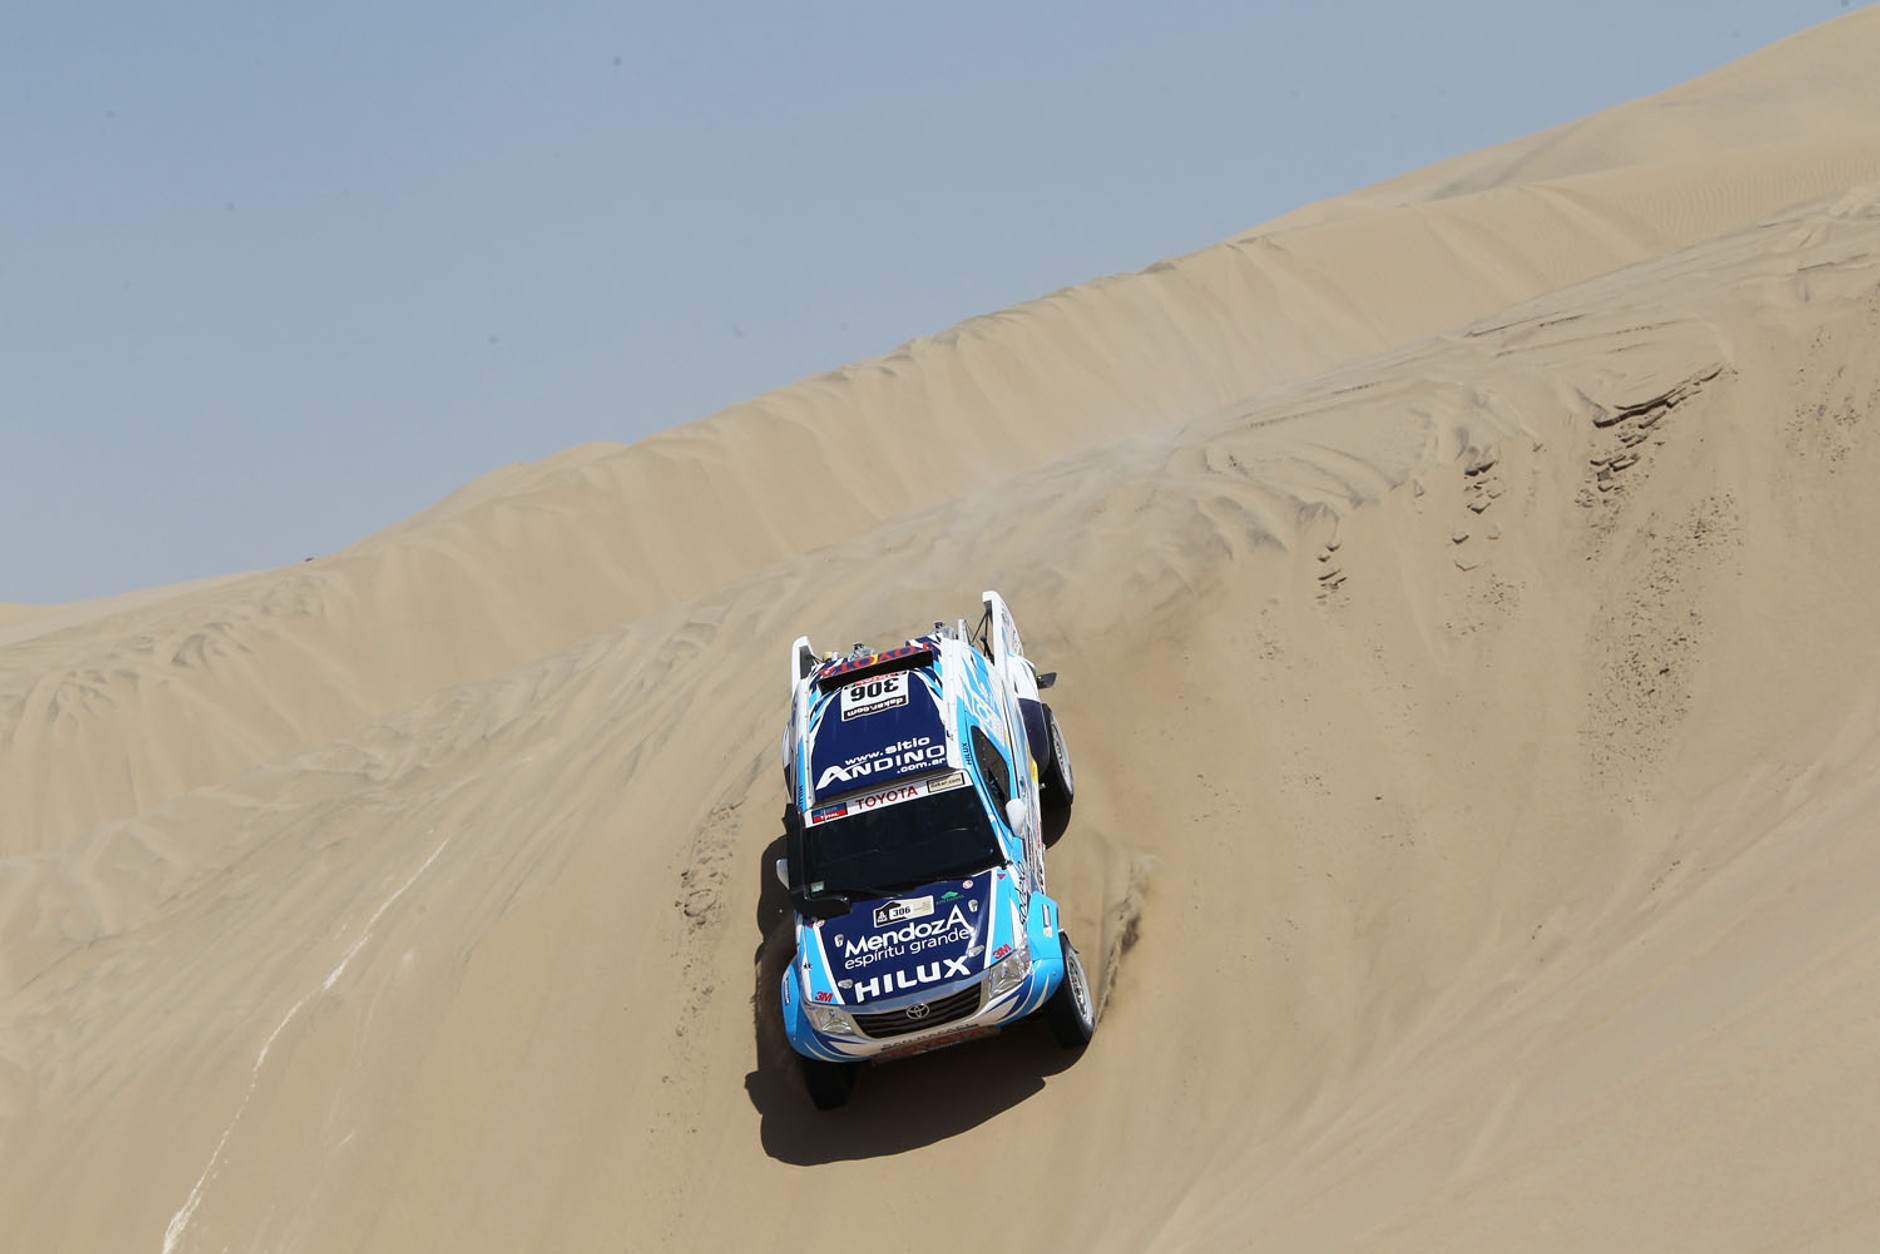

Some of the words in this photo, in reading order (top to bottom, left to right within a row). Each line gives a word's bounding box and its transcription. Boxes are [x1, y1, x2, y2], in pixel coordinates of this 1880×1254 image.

[850, 678, 899, 702] 306
[847, 697, 904, 717] dakar.com
[844, 736, 931, 765] www.sitio
[815, 744, 946, 790] ANDINO
[855, 786, 918, 810] TOYOTA
[892, 906, 911, 917] 306
[909, 927, 970, 954] grande
[993, 944, 1012, 959] 3M
[854, 955, 971, 1004] HILUX
[815, 991, 833, 1002] 3M
